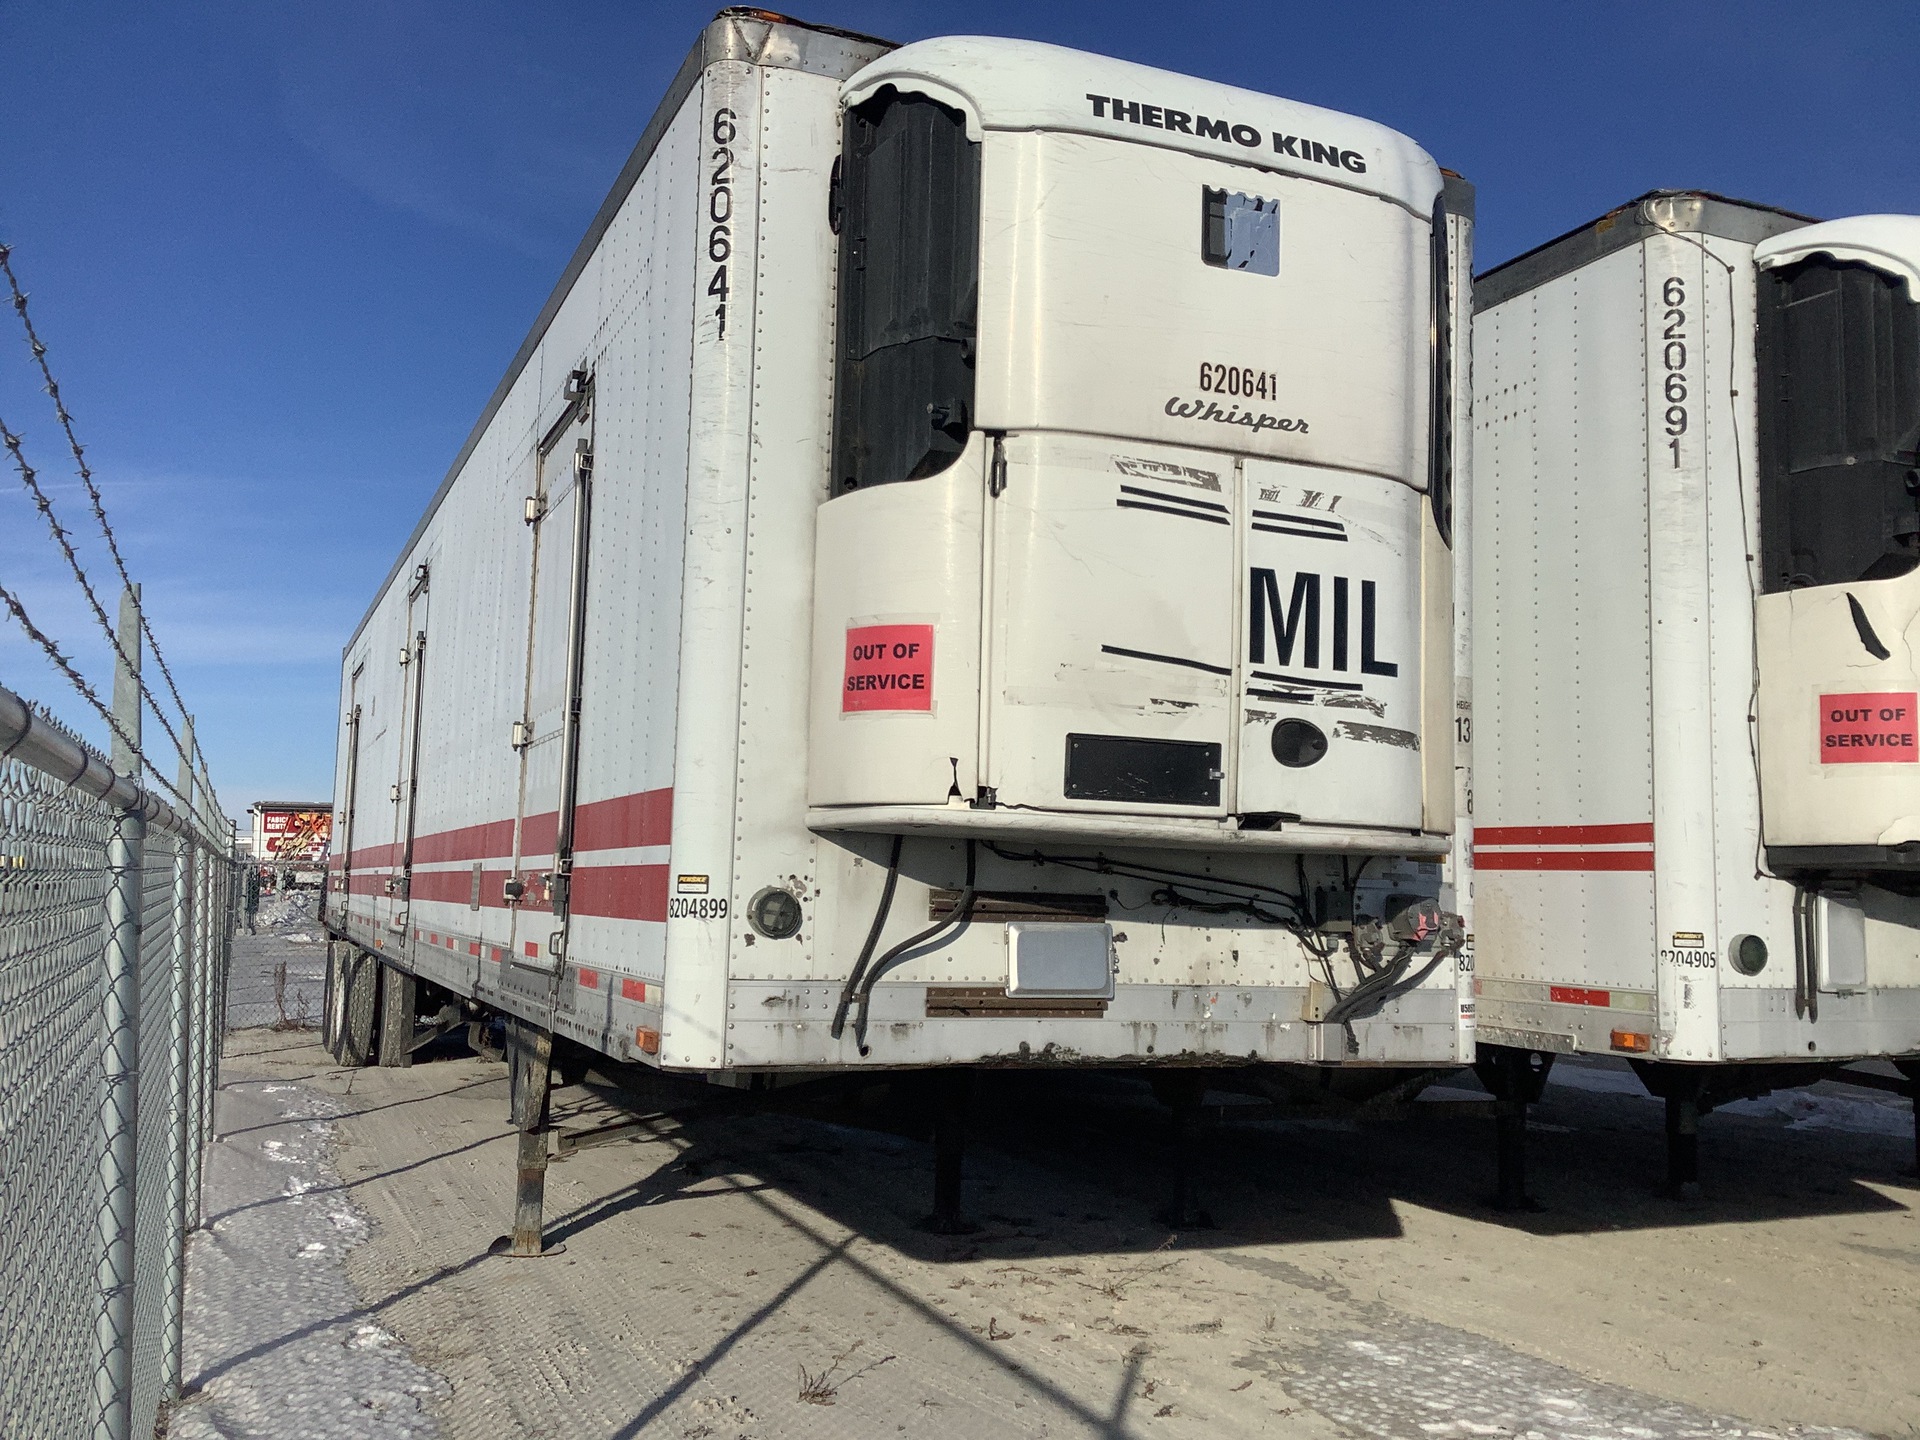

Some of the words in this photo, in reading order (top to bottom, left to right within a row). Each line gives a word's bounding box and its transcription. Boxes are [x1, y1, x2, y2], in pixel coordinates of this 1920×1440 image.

[1086, 93, 1262, 148] THERMO
[1272, 131, 1367, 174] KING
[707, 107, 737, 341] 620641
[1200, 362, 1277, 401] 620641
[1663, 276, 1688, 469] 620691
[1164, 396, 1309, 434] Whisper
[1249, 566, 1398, 678] MIL
[853, 644, 887, 661] OUT
[893, 643, 920, 659] OF
[847, 673, 925, 691] SERVICE
[1830, 708, 1872, 722] OUT
[1879, 708, 1906, 722] OF
[1825, 733, 1913, 747] SERVICE
[669, 898, 728, 919] 8204899
